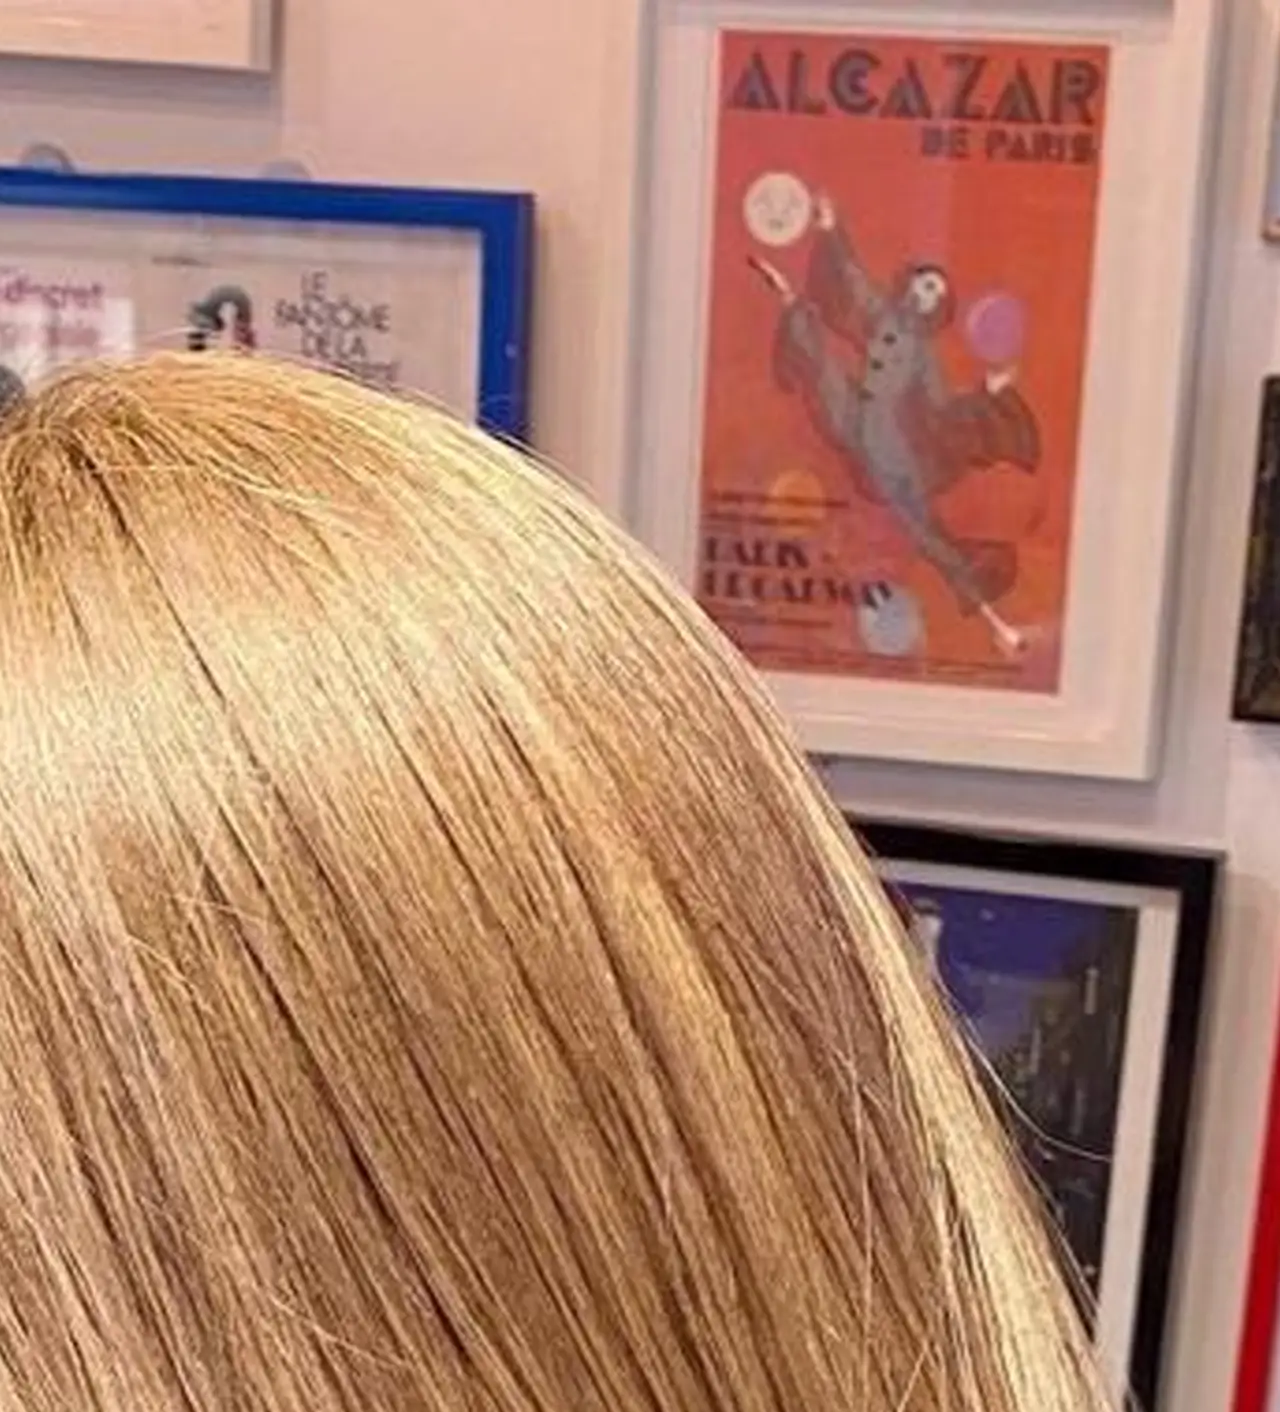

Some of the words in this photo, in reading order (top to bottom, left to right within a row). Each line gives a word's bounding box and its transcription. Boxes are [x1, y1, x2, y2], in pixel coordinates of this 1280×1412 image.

[723, 47, 1100, 127] ALCAZAR
[921, 125, 970, 160] DE
[984, 127, 1100, 165] PARIS
